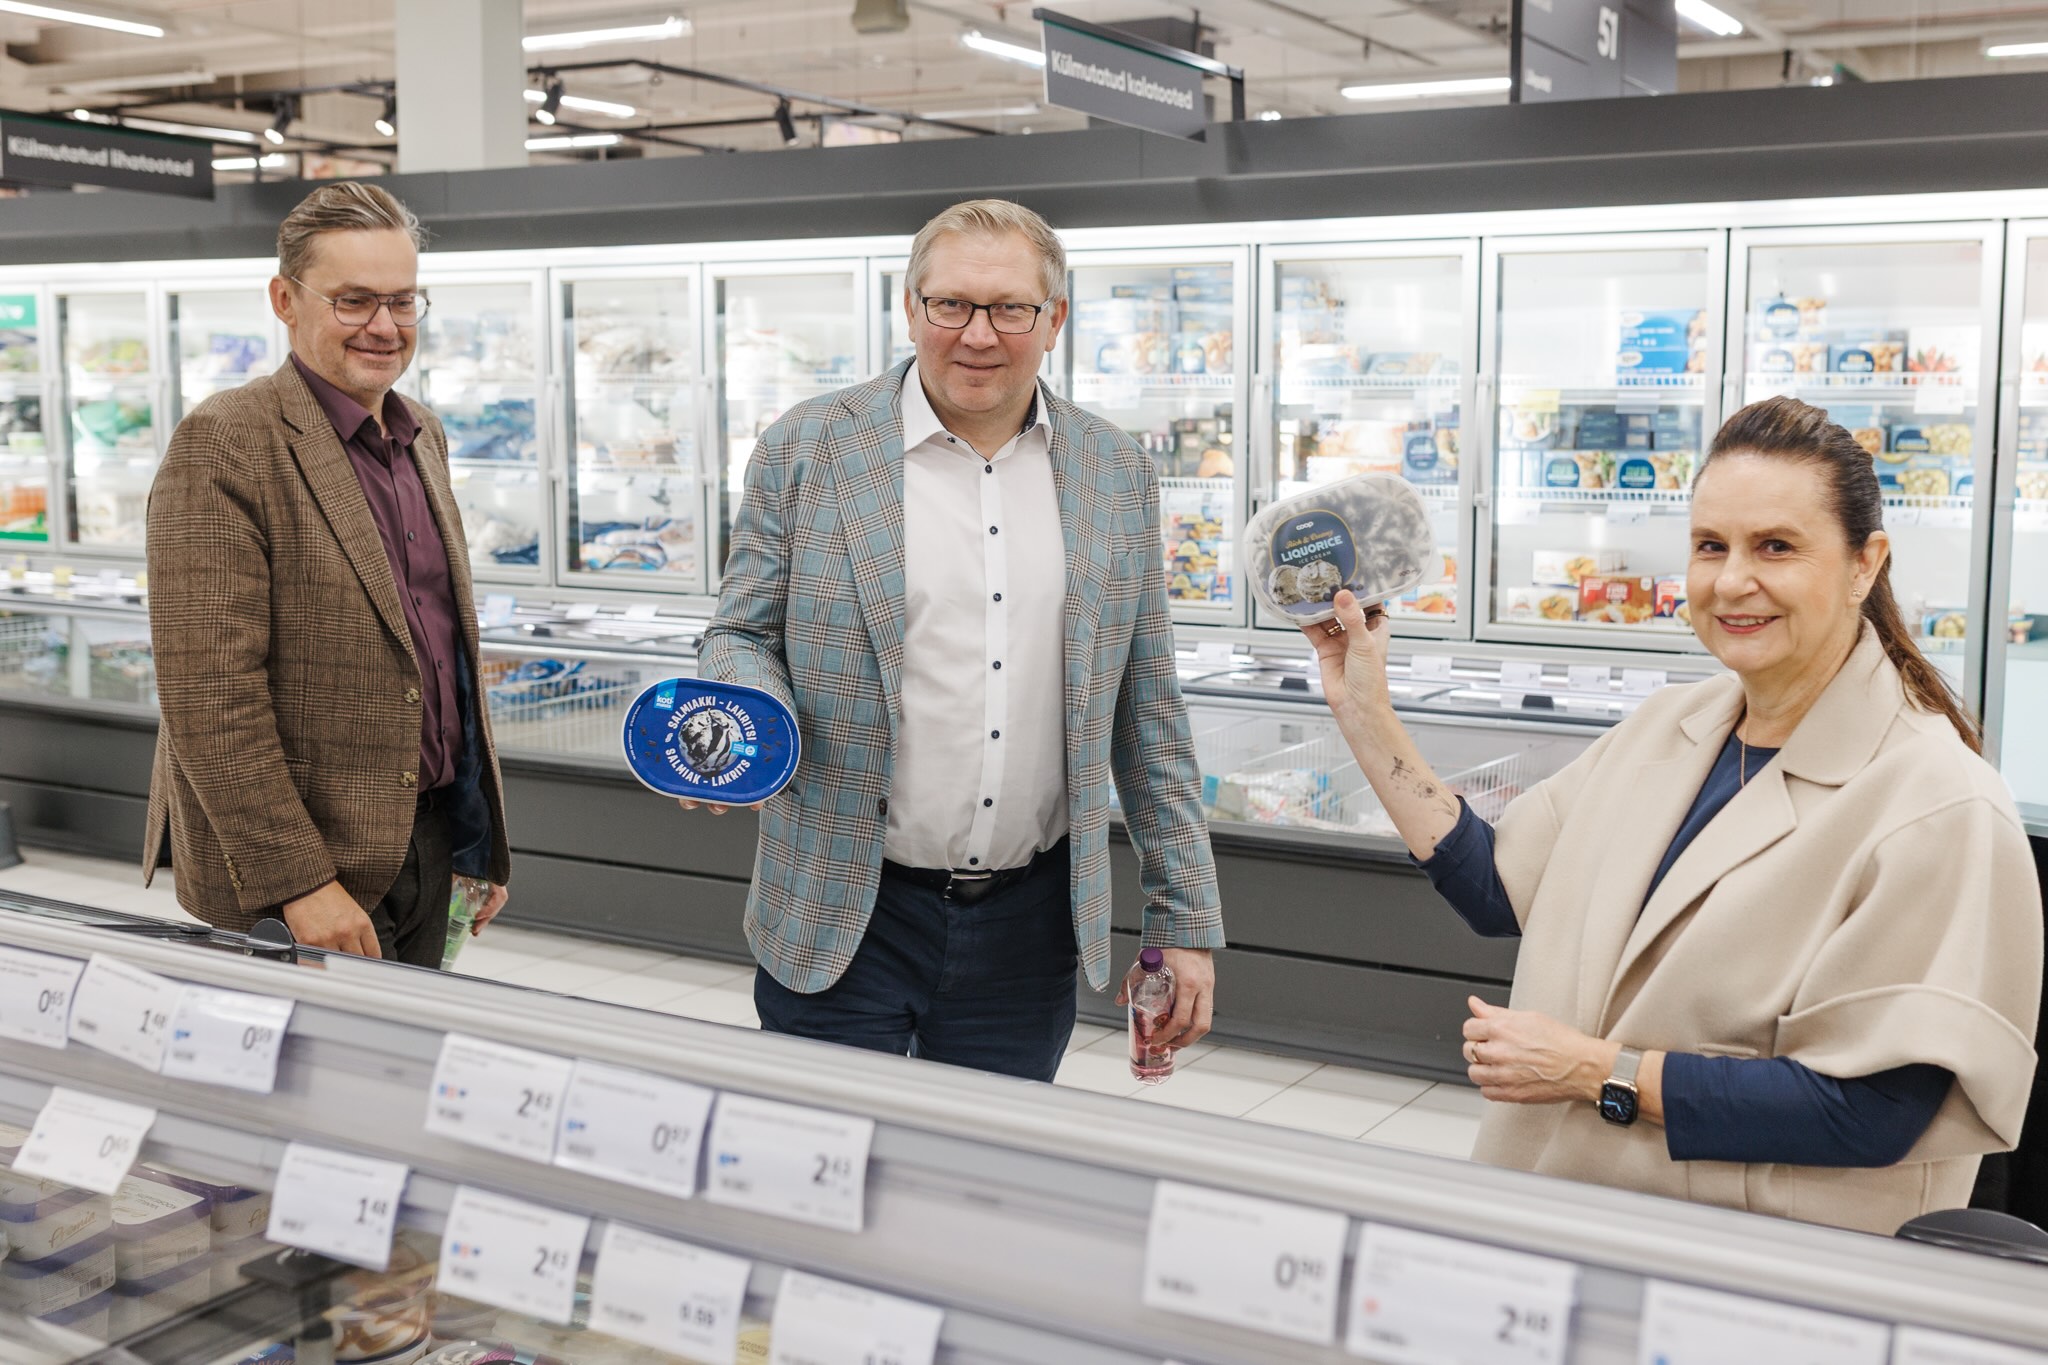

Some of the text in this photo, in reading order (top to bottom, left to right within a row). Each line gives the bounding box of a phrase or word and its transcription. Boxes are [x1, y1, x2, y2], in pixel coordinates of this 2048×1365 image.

[1051, 50, 1193, 110] Külmutatud kalatooted
[7, 134, 194, 178] Külmutatud lihatooted
[1296, 521, 1314, 531] coop
[1281, 535, 1344, 562] LIQUORICE
[1311, 550, 1331, 561] CREAM
[667, 696, 716, 729] SALMIAKKI
[726, 700, 757, 741] LAKRITSI
[665, 748, 701, 784] SALMIAK
[712, 759, 751, 787] LAKRITS
